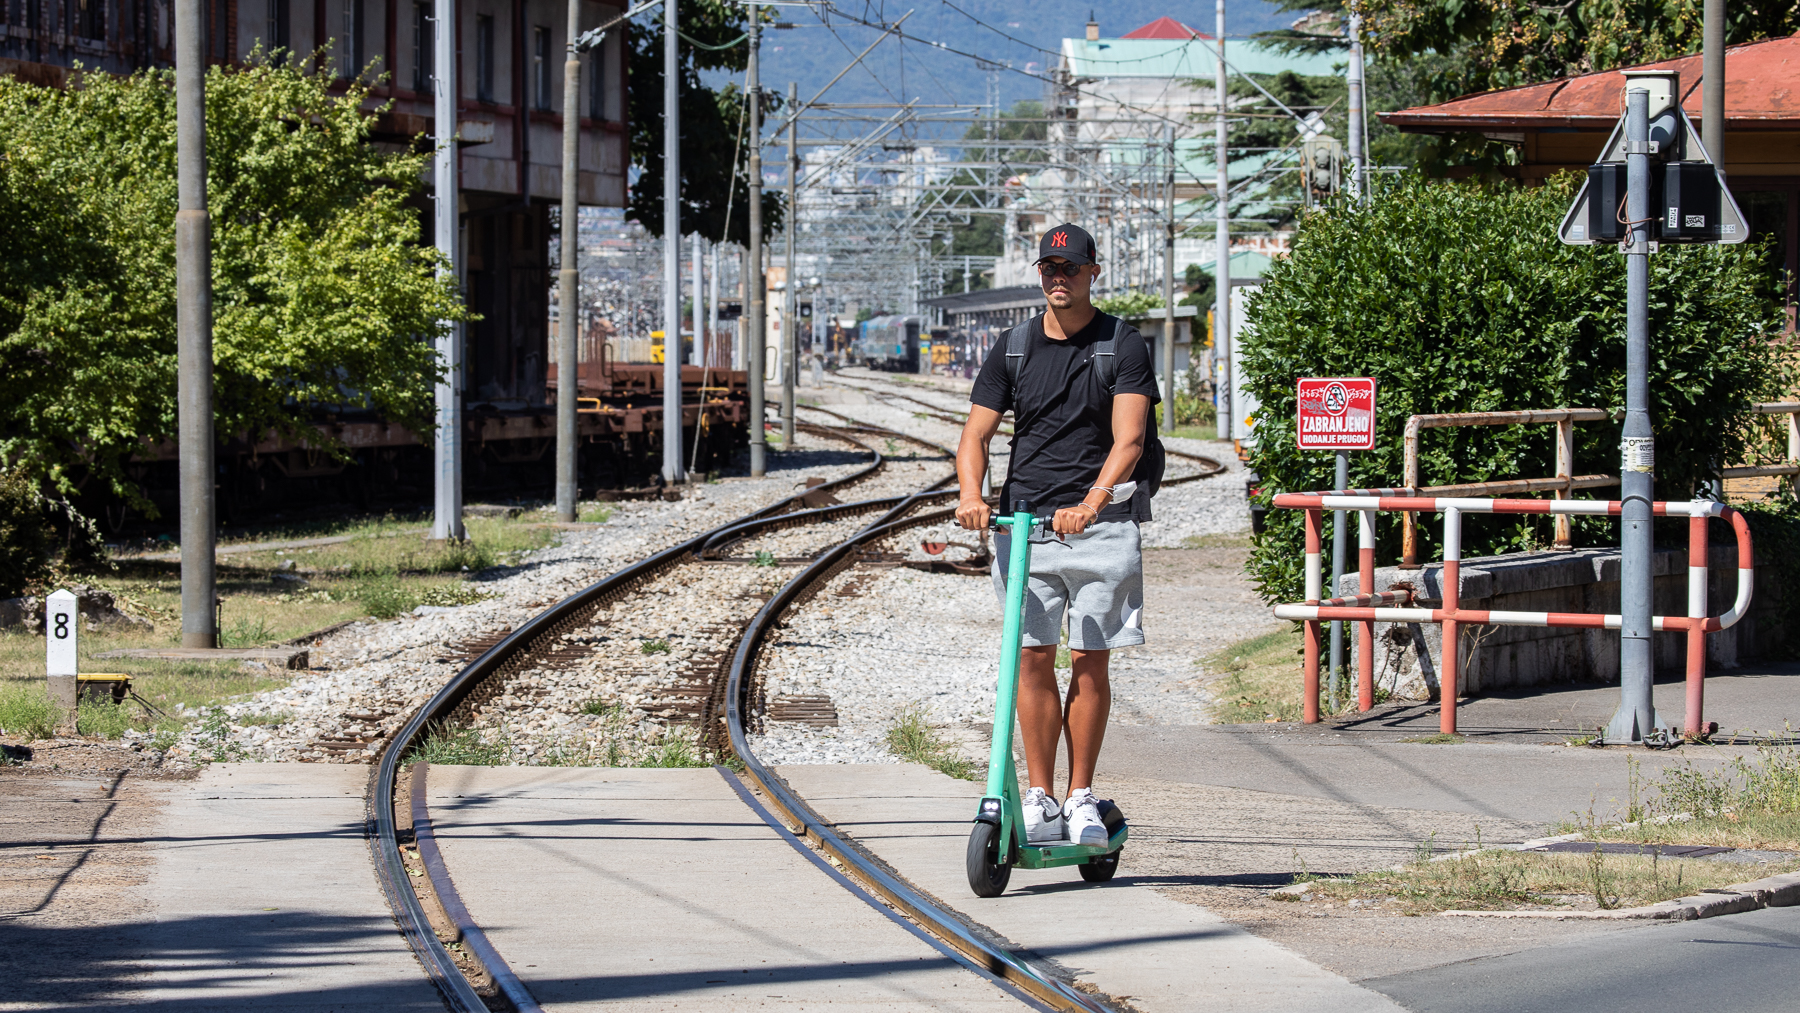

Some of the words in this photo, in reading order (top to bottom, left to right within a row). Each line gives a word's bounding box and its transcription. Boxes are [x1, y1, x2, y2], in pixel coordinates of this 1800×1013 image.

[1302, 416, 1369, 433] ZABRANJENO
[1302, 434, 1336, 444] HODANJE
[1337, 434, 1368, 444] PRUGOM
[54, 612, 69, 640] 8
